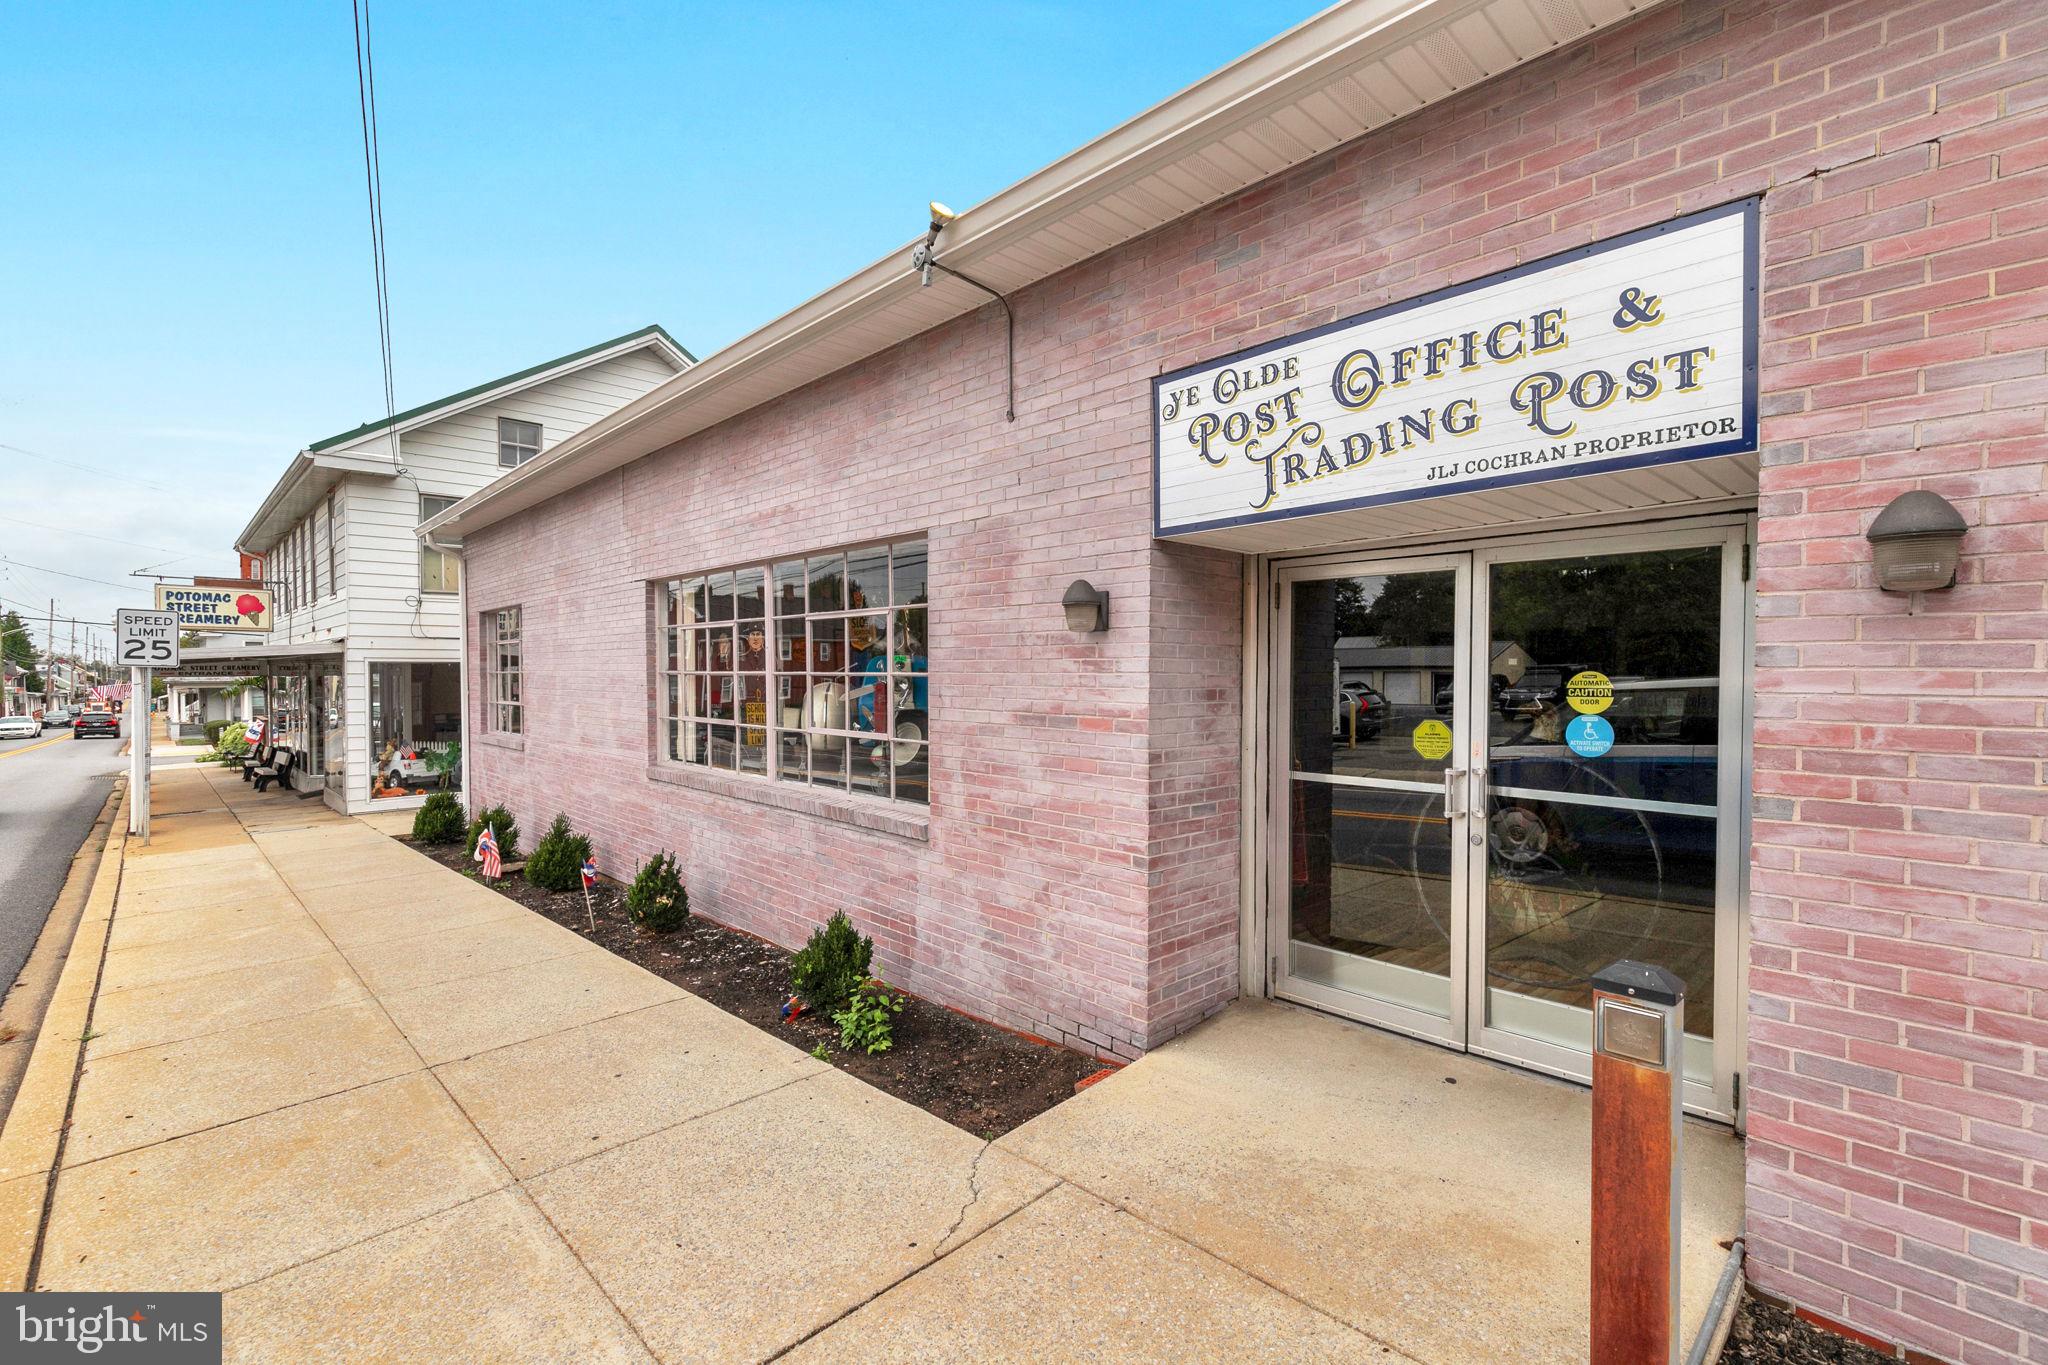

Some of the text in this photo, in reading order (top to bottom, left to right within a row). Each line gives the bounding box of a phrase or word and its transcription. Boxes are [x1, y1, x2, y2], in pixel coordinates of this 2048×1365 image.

[1188, 287, 1664, 465] POST OFFICE &
[1245, 346, 1715, 510] TRADING POST
[1427, 417, 1737, 480] JLJ COCHRAN PROPRIETOR
[165, 590, 231, 603] POTOMAC
[166, 602, 218, 613] STREET
[124, 615, 173, 626] SPEED
[180, 614, 240, 625] REAMERY
[130, 627, 167, 637] LIMIT
[124, 639, 172, 660] 25
[1568, 688, 1612, 697] CAUTION
